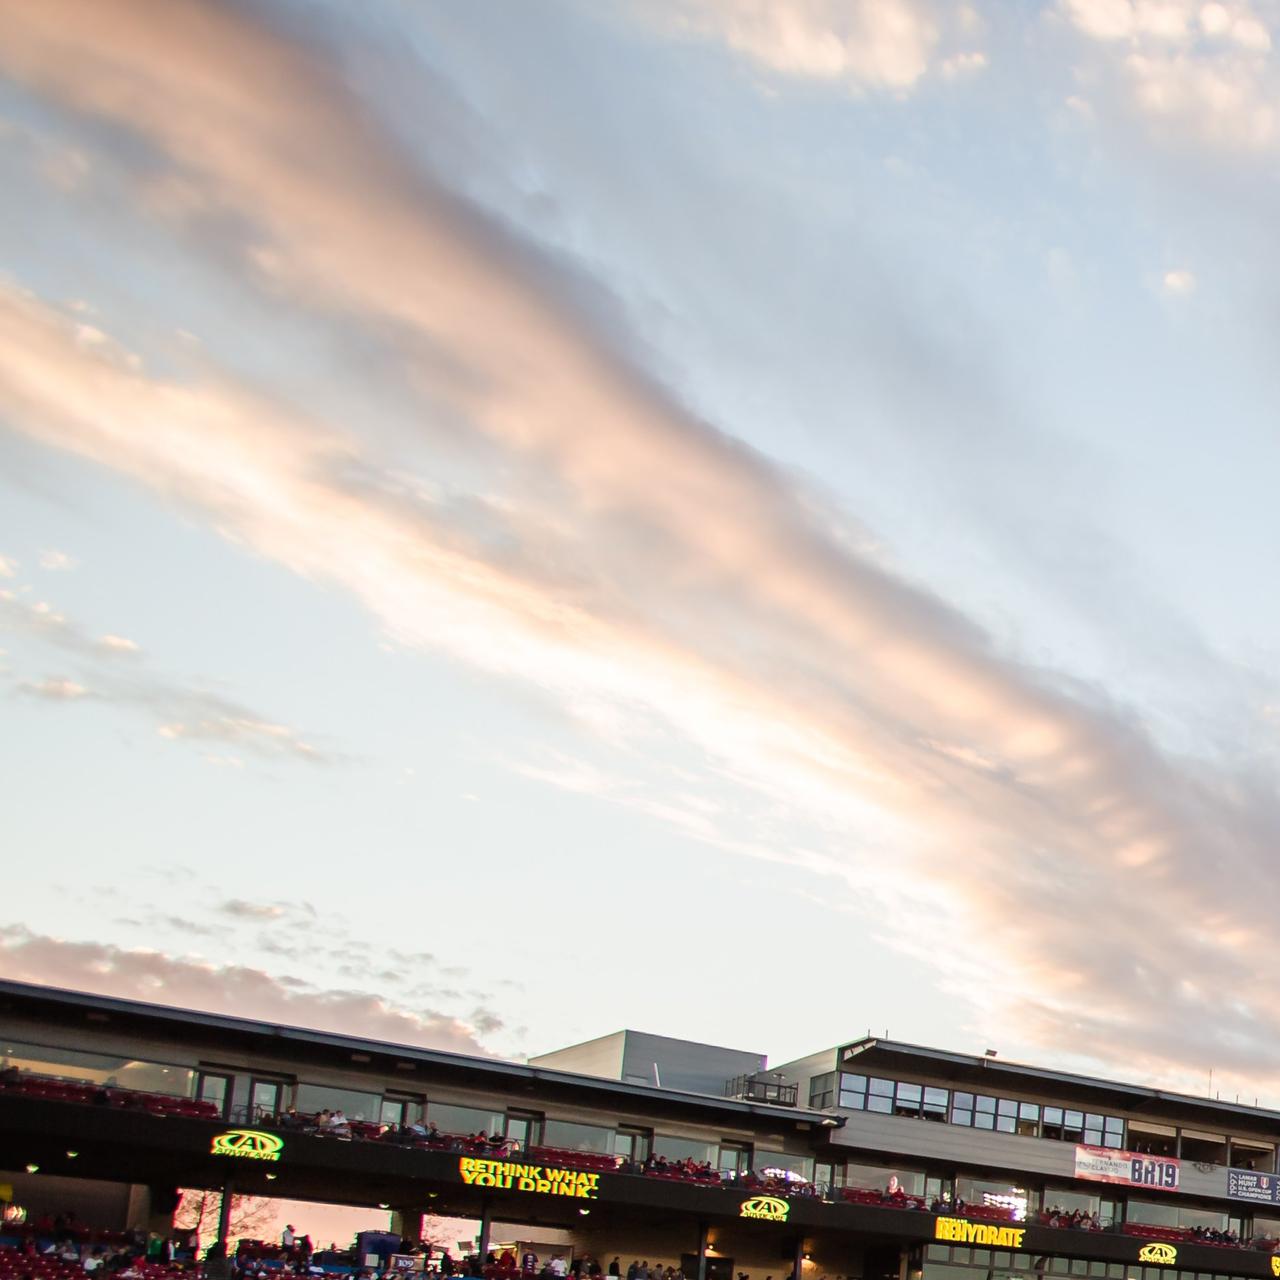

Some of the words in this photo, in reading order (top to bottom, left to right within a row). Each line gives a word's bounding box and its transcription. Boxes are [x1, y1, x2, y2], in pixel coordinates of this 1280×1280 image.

[459, 1157, 542, 1180] RETHINK
[545, 1167, 600, 1187] WHAT
[460, 1170, 512, 1189] YOU
[1238, 1191, 1271, 1200] CHAMPIONS
